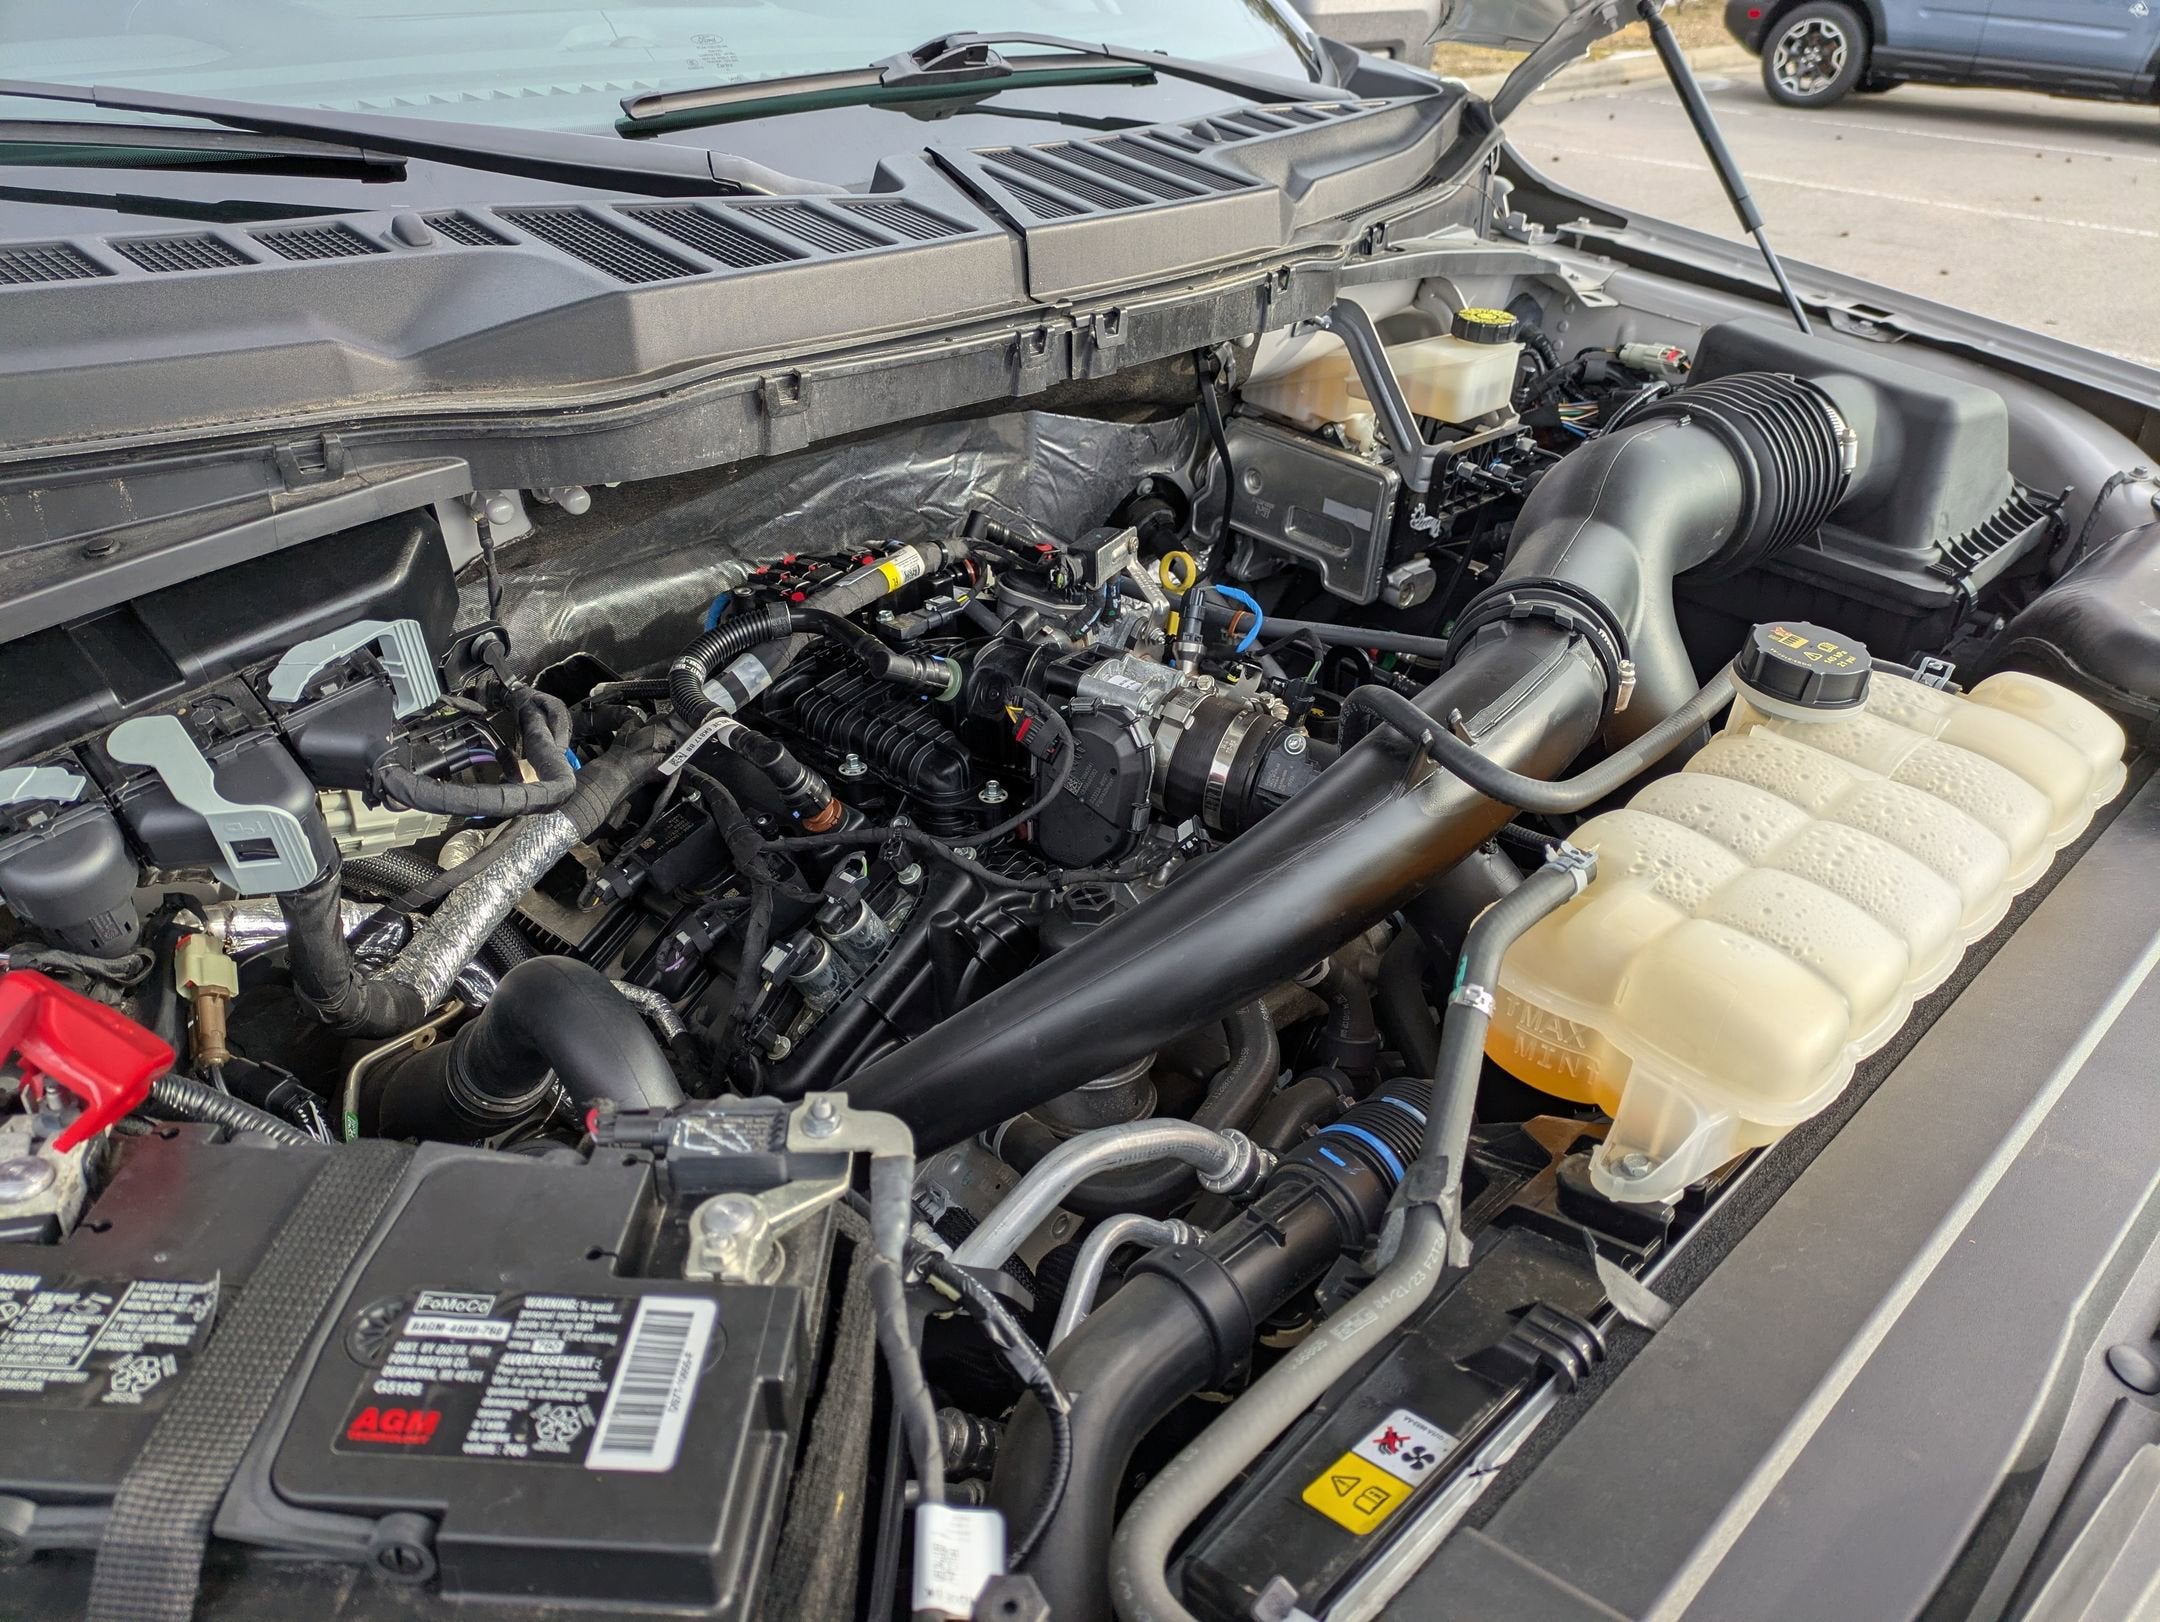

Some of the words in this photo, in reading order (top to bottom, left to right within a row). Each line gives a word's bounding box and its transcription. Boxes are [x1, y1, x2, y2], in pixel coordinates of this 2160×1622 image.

[1520, 1005, 1586, 1049] MAX
[1514, 1032, 1580, 1078] MIN
[419, 1295, 491, 1315] FoMoCo
[350, 1407, 442, 1435] AGM
